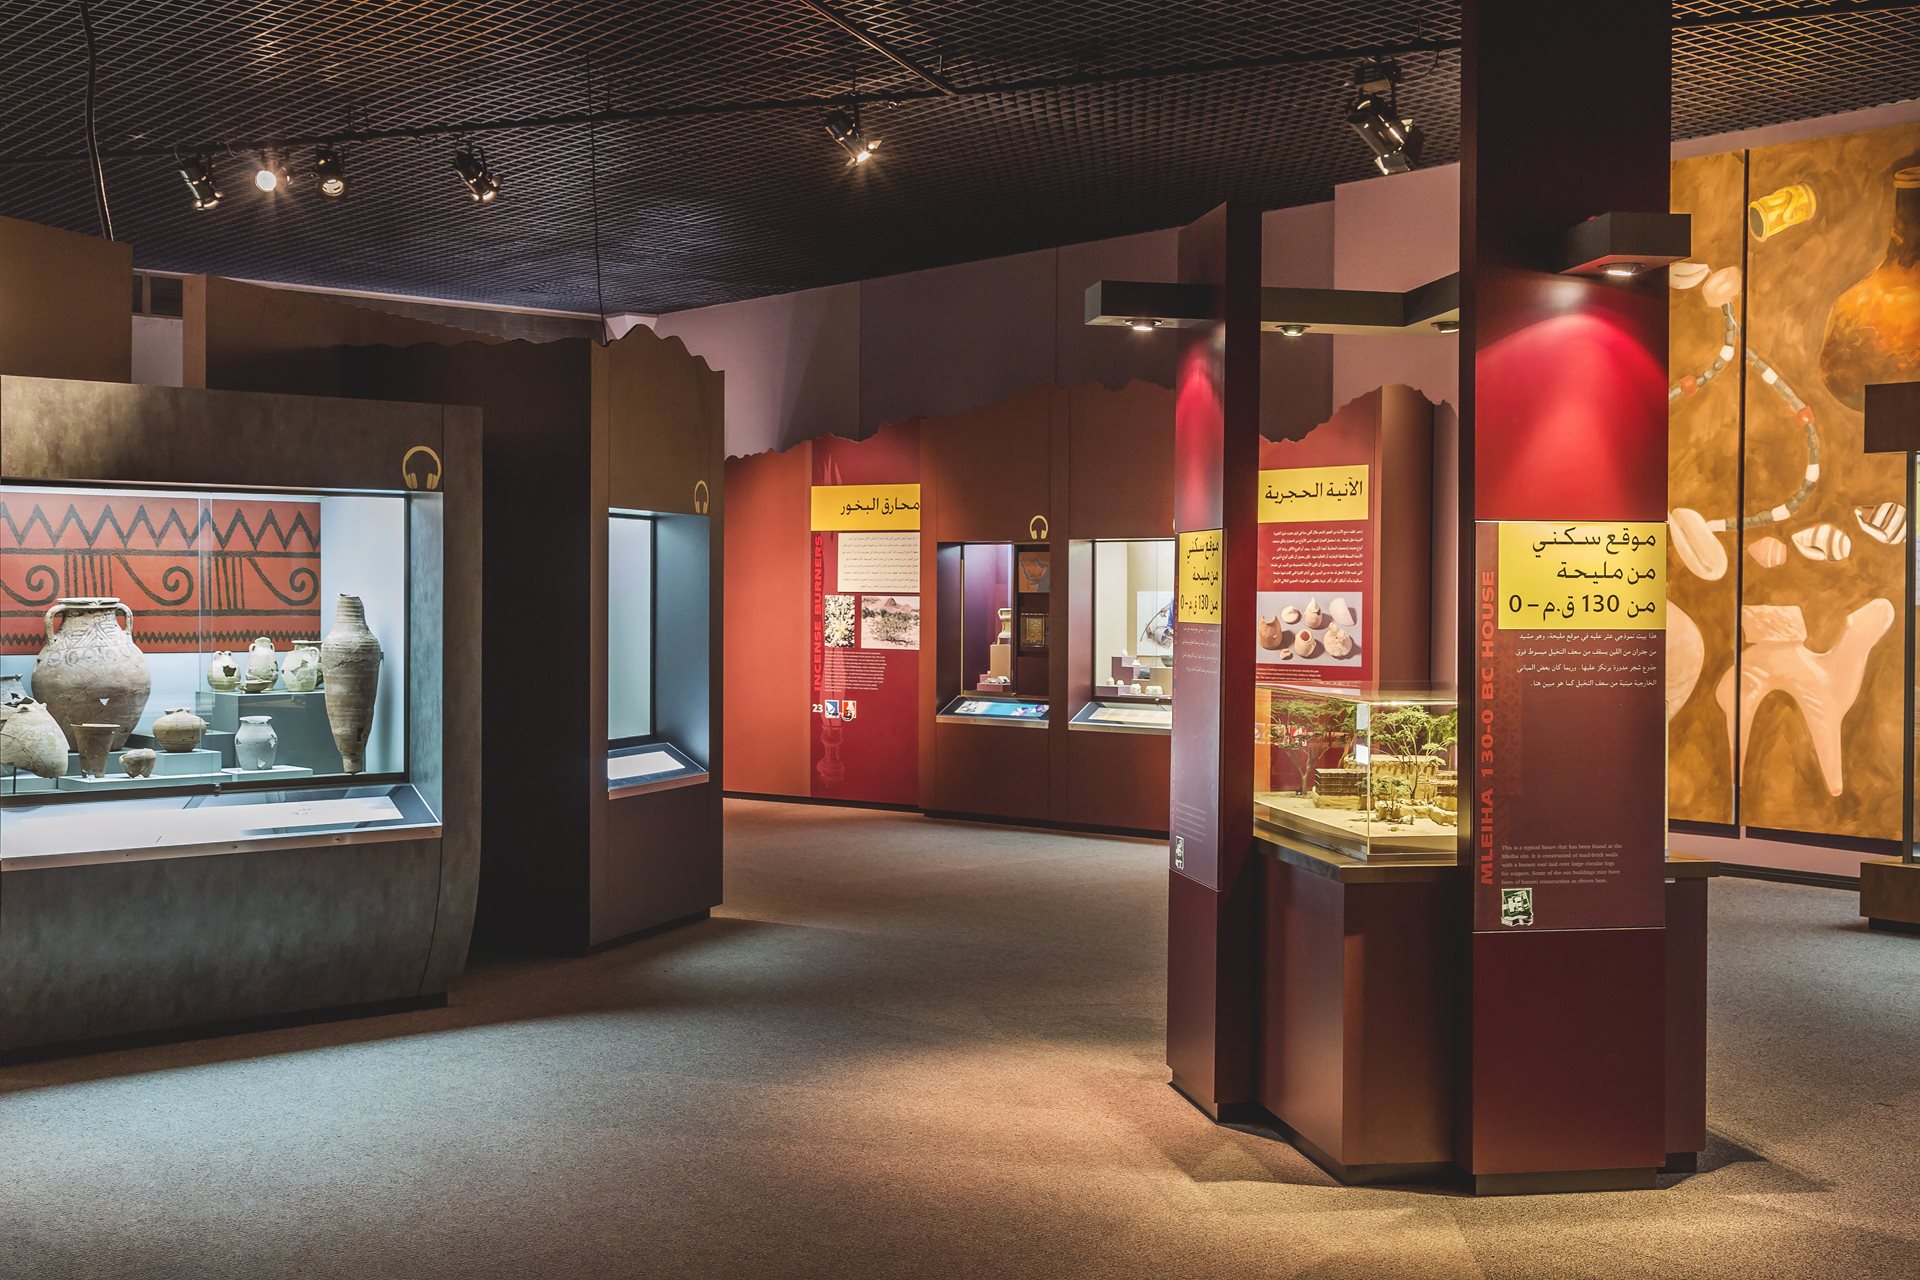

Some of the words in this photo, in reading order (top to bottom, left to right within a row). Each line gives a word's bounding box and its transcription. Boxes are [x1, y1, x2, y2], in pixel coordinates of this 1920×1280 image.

[1265, 482, 1323, 504] الحجرية
[1327, 477, 1363, 501] الآنية
[840, 498, 879, 515] البخور
[882, 498, 920, 514] محارق
[1533, 527, 1601, 558] سكني
[1606, 527, 1656, 554] موقع
[815, 536, 823, 615] BURNERS
[1557, 561, 1623, 585] مليحة
[1627, 566, 1656, 585] من
[1482, 571, 1494, 658] HOUSE
[1582, 594, 1620, 612] 130
[1627, 599, 1656, 618] من
[814, 621, 822, 691] INCENSE
[1482, 667, 1494, 700] BC
[812, 704, 824, 713] 23
[1481, 709, 1494, 777] 130-0
[1481, 789, 1494, 885] MLEIHA
